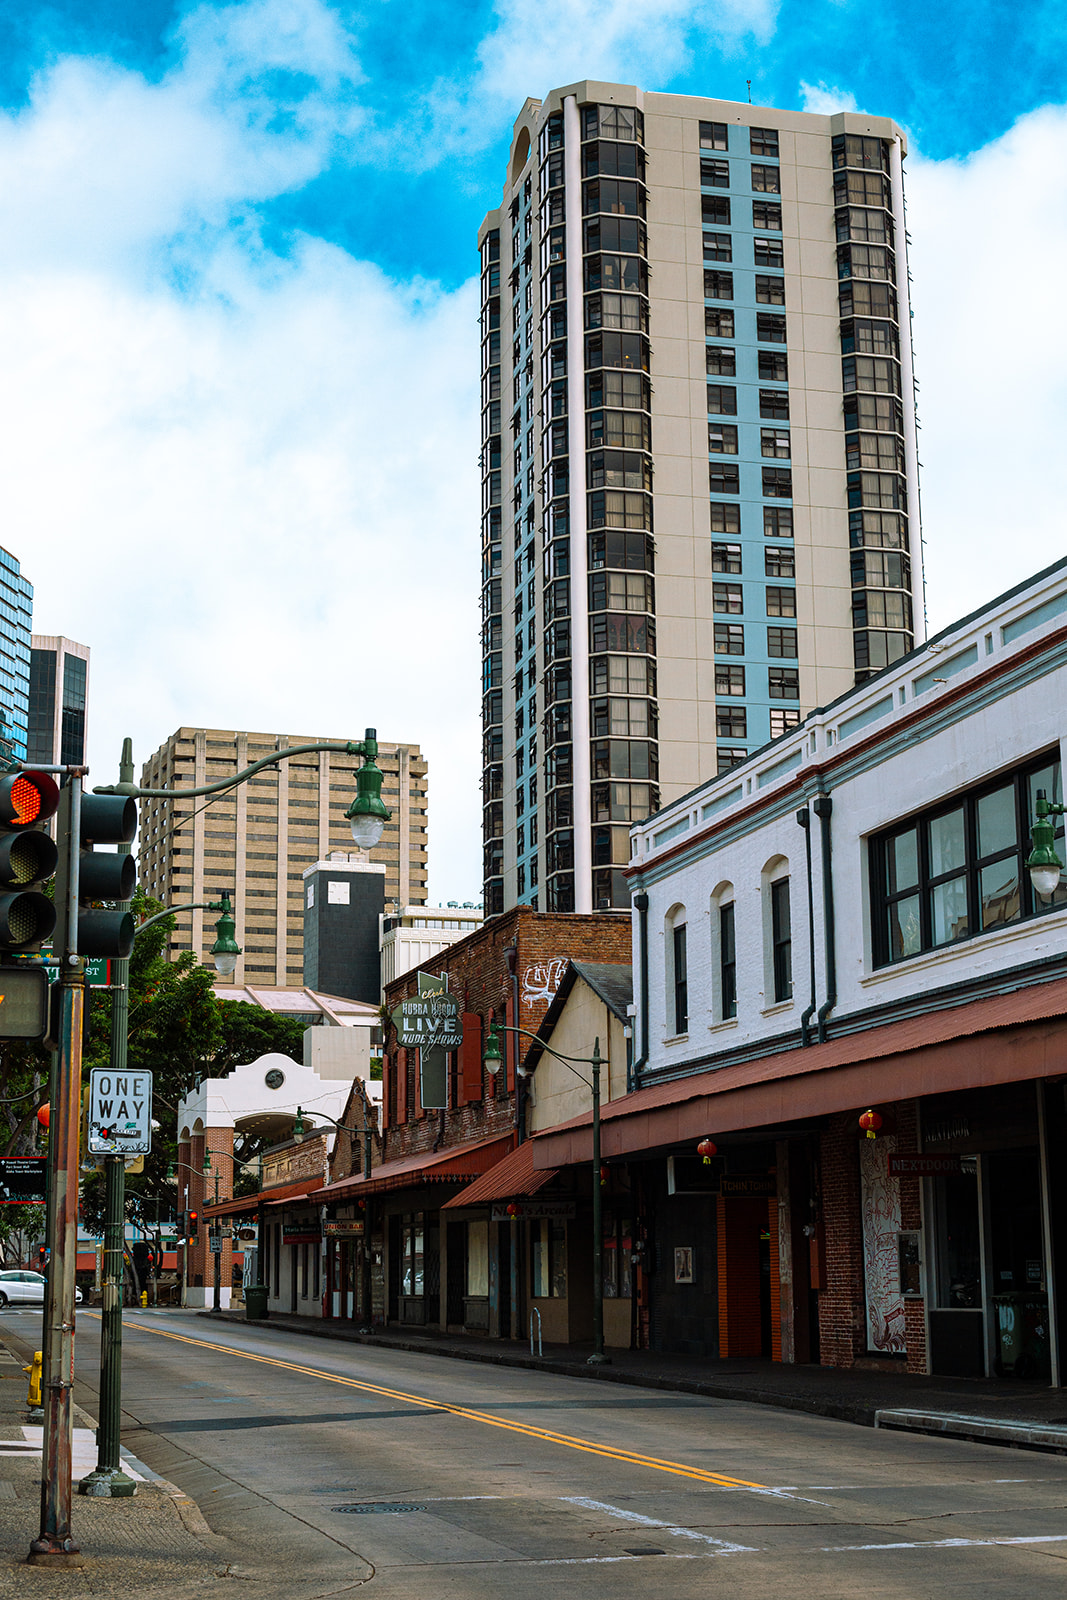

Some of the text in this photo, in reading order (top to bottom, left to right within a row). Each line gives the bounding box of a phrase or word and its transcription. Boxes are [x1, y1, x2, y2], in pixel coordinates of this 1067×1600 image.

[86, 967, 99, 976] ST
[421, 987, 445, 1000] Club
[402, 1003, 428, 1015] HUBBA
[403, 1017, 457, 1032] LIVE
[401, 1033, 463, 1045] NUDE SHOWS
[99, 1077, 144, 1096] ONE
[98, 1099, 144, 1119] WAY
[891, 1159, 959, 1171] NEXTDOOR
[535, 1203, 575, 1216] Arcade
